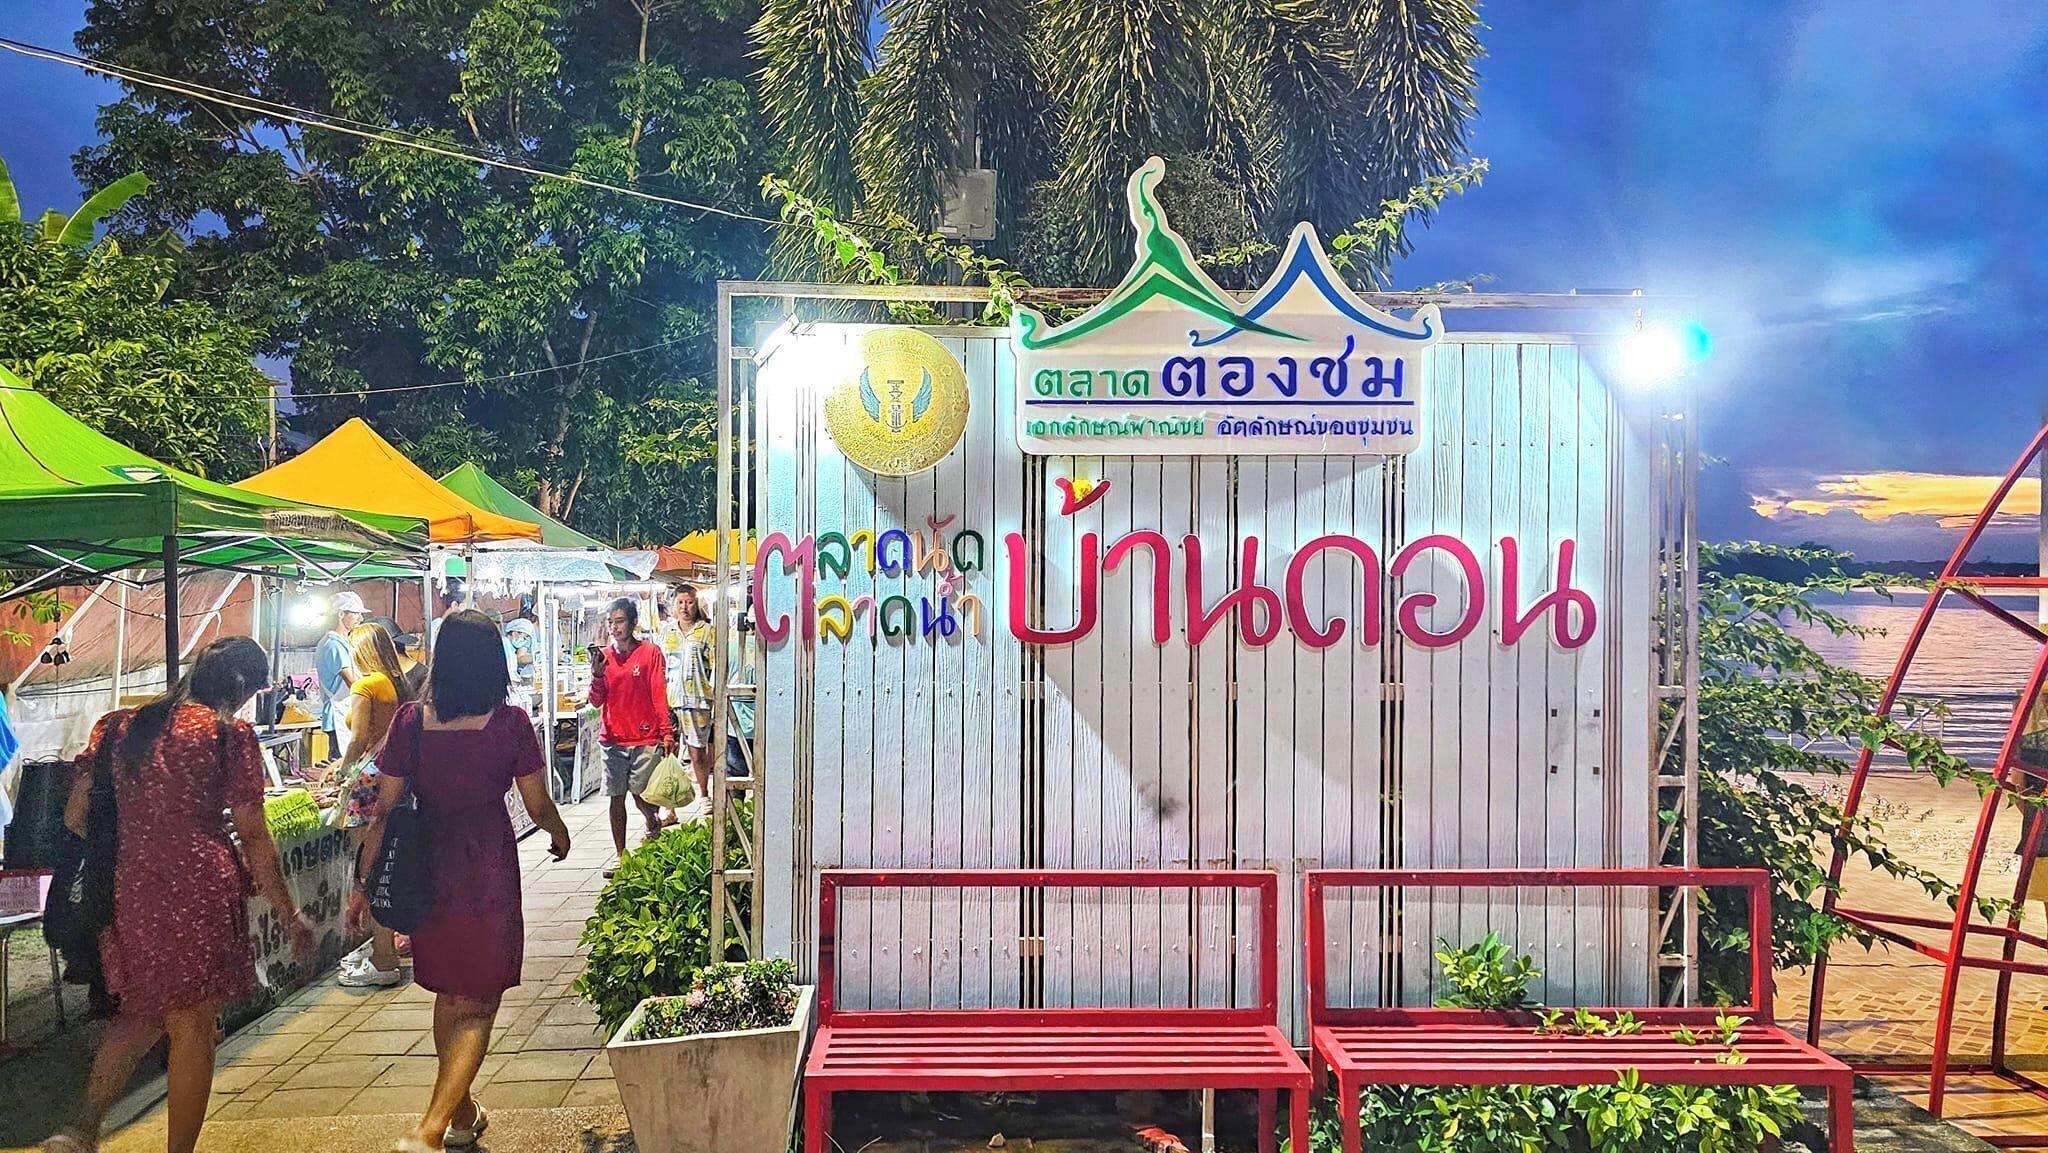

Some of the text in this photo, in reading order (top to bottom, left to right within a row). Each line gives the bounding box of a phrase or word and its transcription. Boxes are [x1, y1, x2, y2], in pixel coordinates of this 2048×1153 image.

[1034, 367, 1150, 398] ตลาด
[1217, 413, 1415, 446] อัตลักษณ์ของชุมชน
[1003, 477, 1597, 648] บ้านดอน
